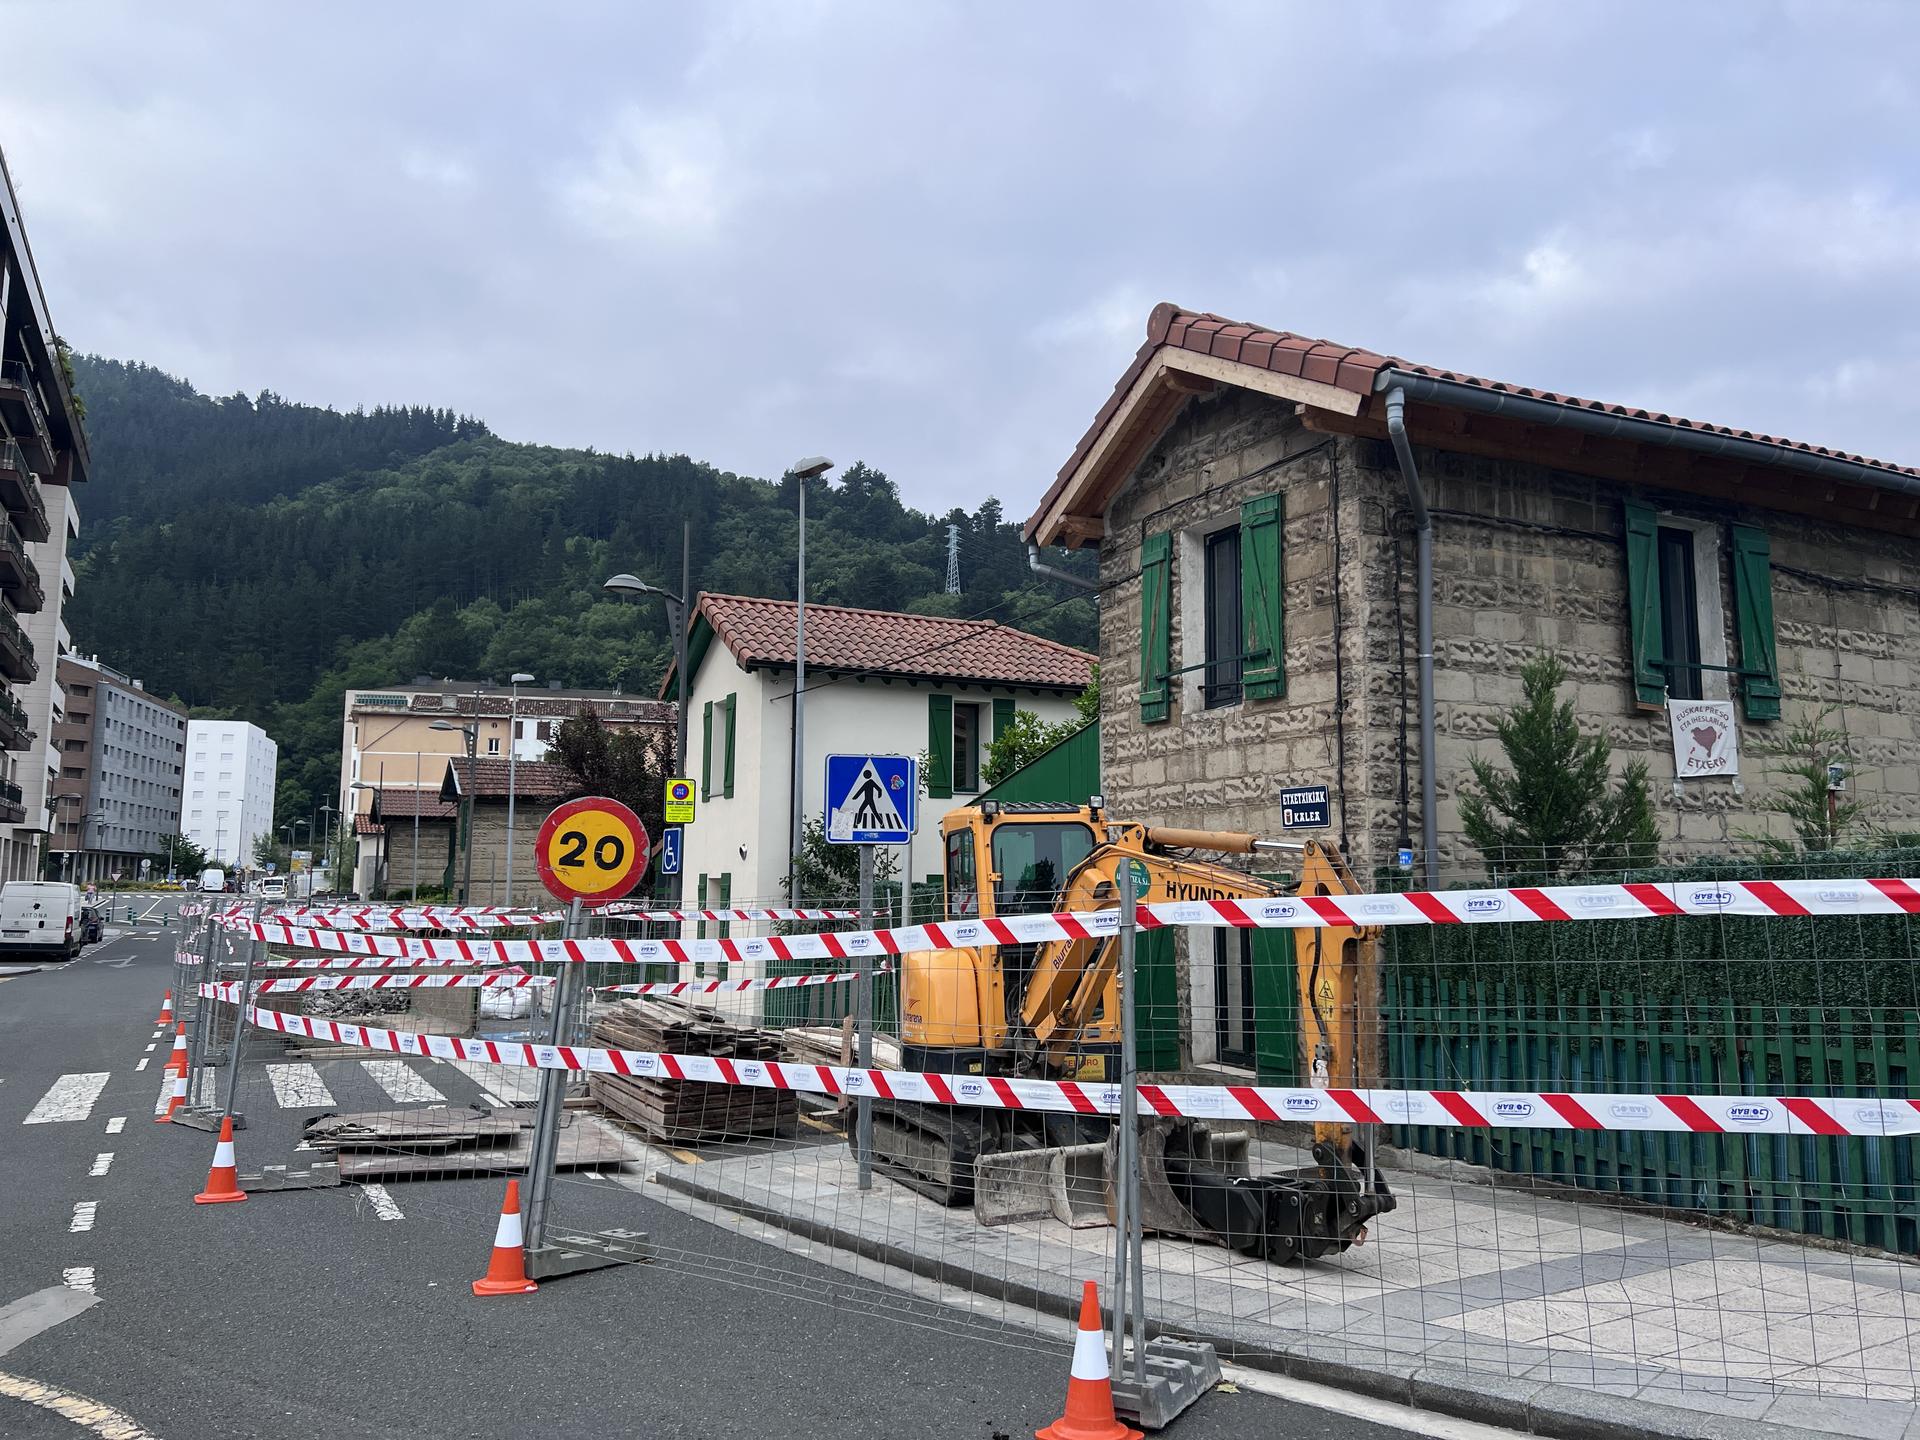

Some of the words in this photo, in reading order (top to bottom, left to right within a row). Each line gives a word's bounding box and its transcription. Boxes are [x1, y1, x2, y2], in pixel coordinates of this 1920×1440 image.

[1676, 706, 1703, 721] EUSKAL
[1705, 706, 1729, 721] PRESO
[1680, 720, 1691, 731] ETA
[1687, 757, 1727, 769] ETXERA
[1294, 811, 1321, 822] KALEA
[559, 831, 624, 870] 20
